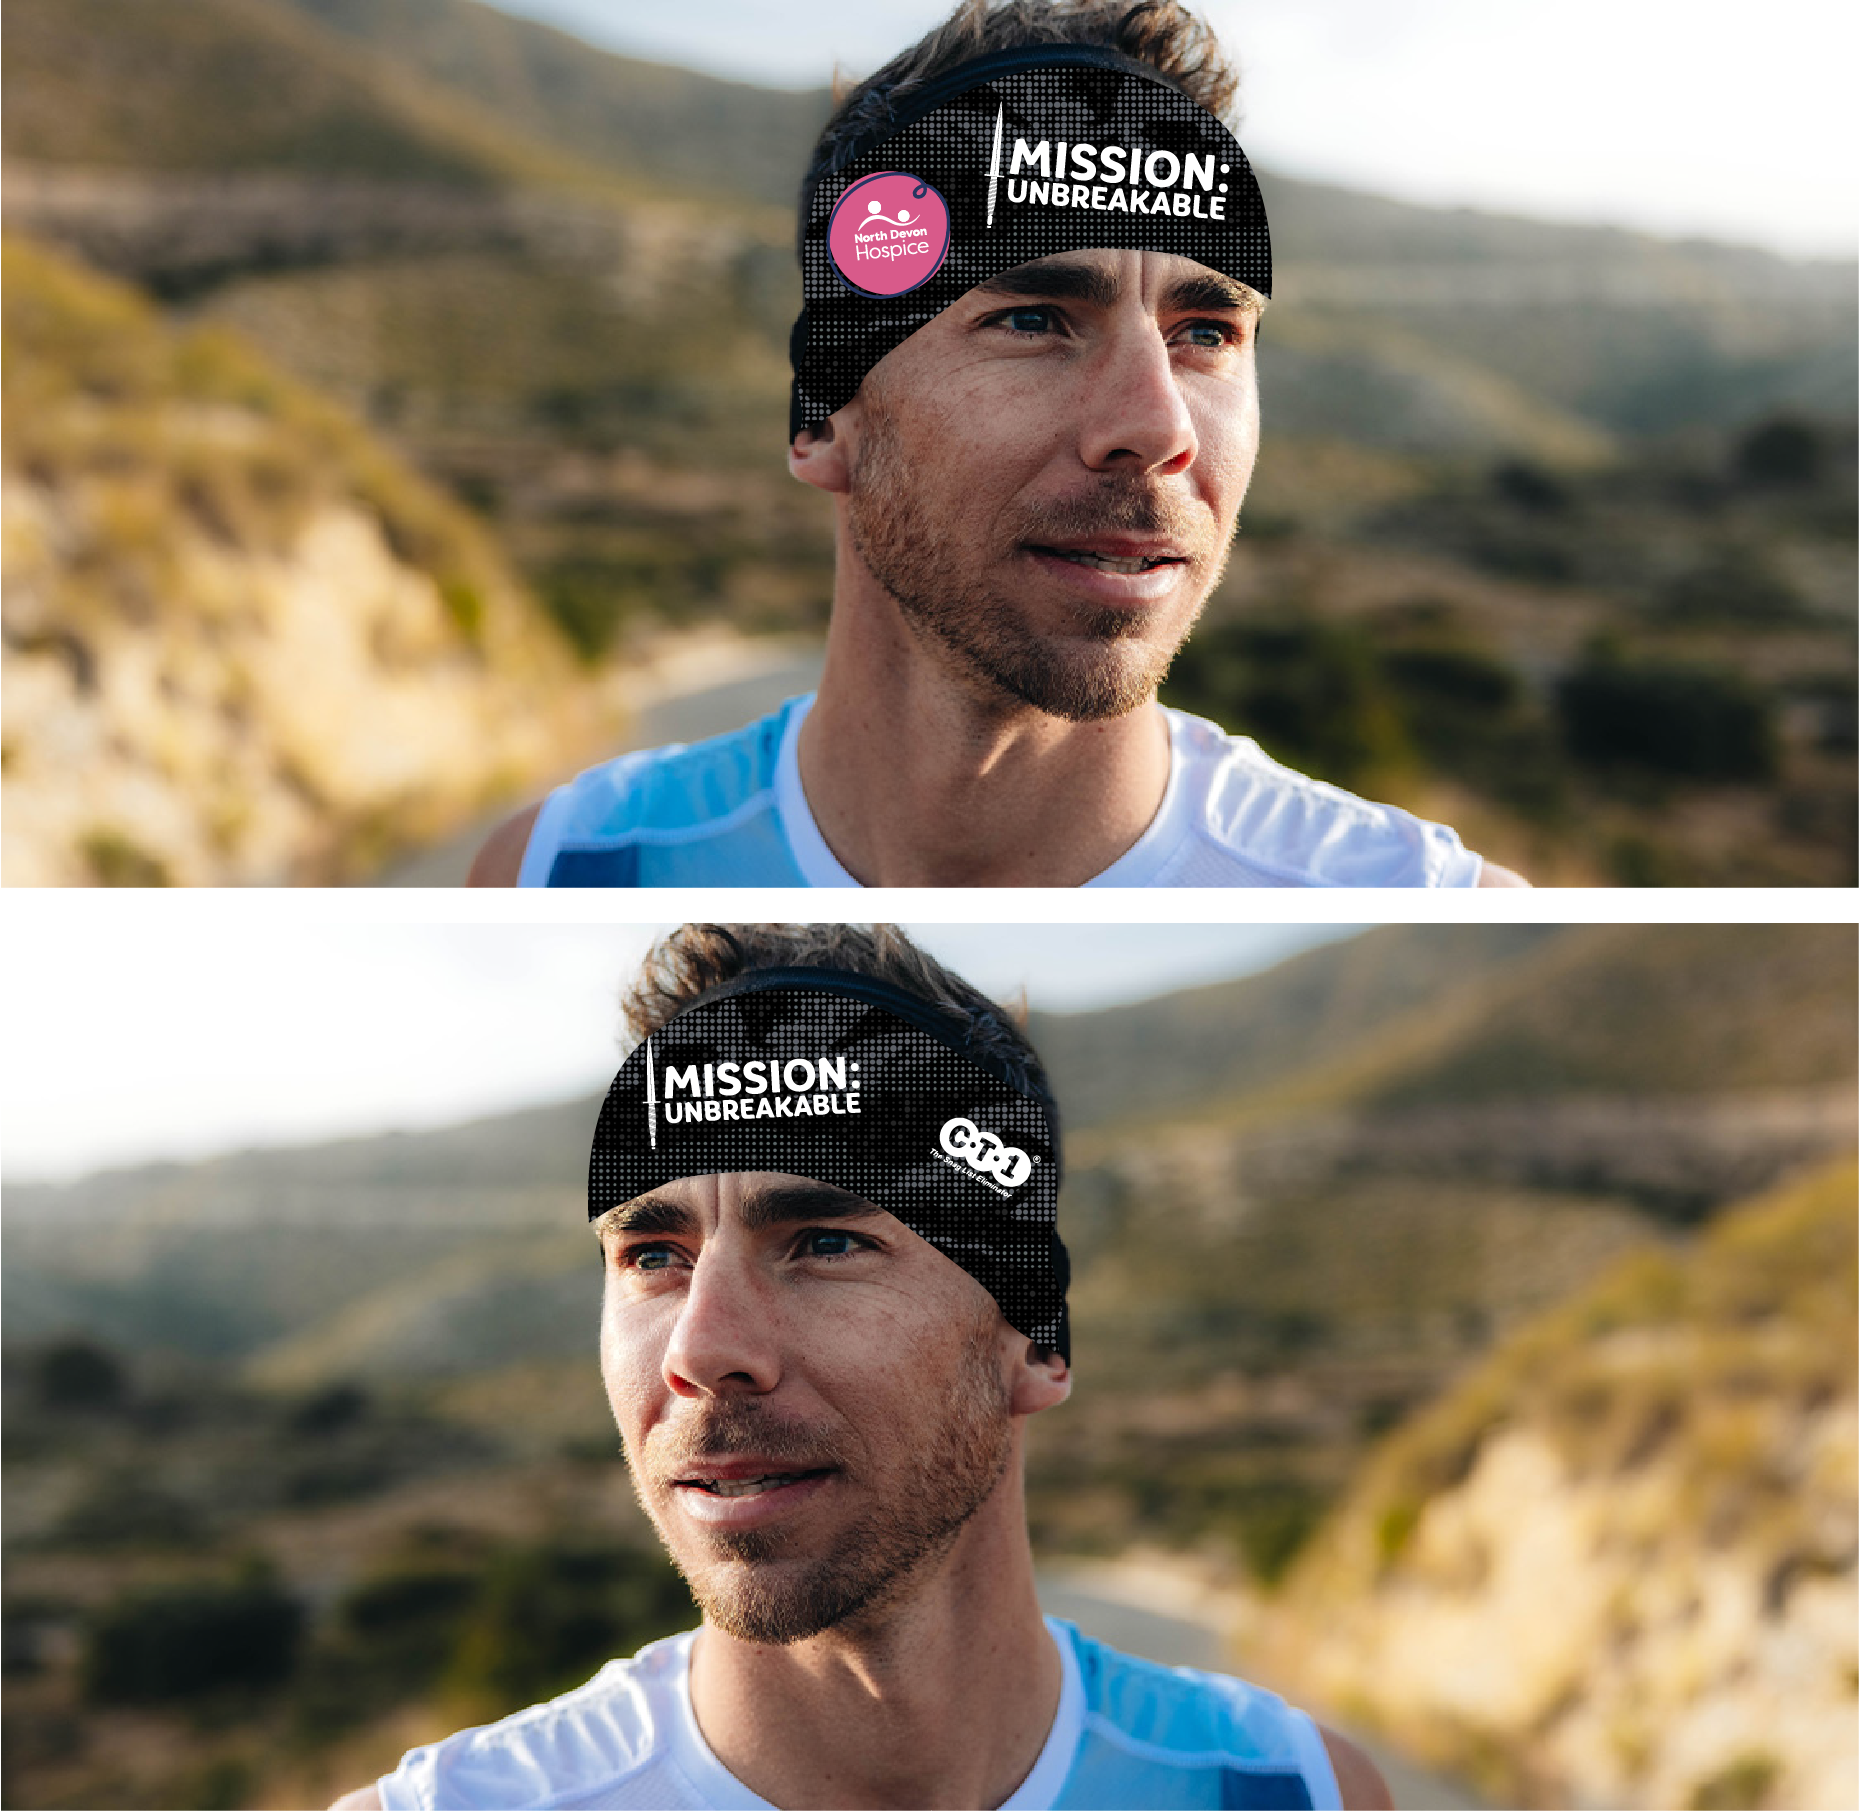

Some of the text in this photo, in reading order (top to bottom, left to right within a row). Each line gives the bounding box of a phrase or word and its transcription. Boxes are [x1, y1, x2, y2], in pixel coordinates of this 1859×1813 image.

[1009, 138, 1230, 193] MISSION:
[1007, 178, 1227, 220] UNBREAKABLE
[854, 228, 928, 244] North Devon
[855, 239, 930, 262] Hospice
[664, 1056, 861, 1099] MISSION:
[664, 1092, 862, 1124] UNBREAKABLE
[943, 1156, 961, 1171] Snag
[961, 1166, 977, 1179] List
[975, 1175, 1013, 1199] Eliminator
